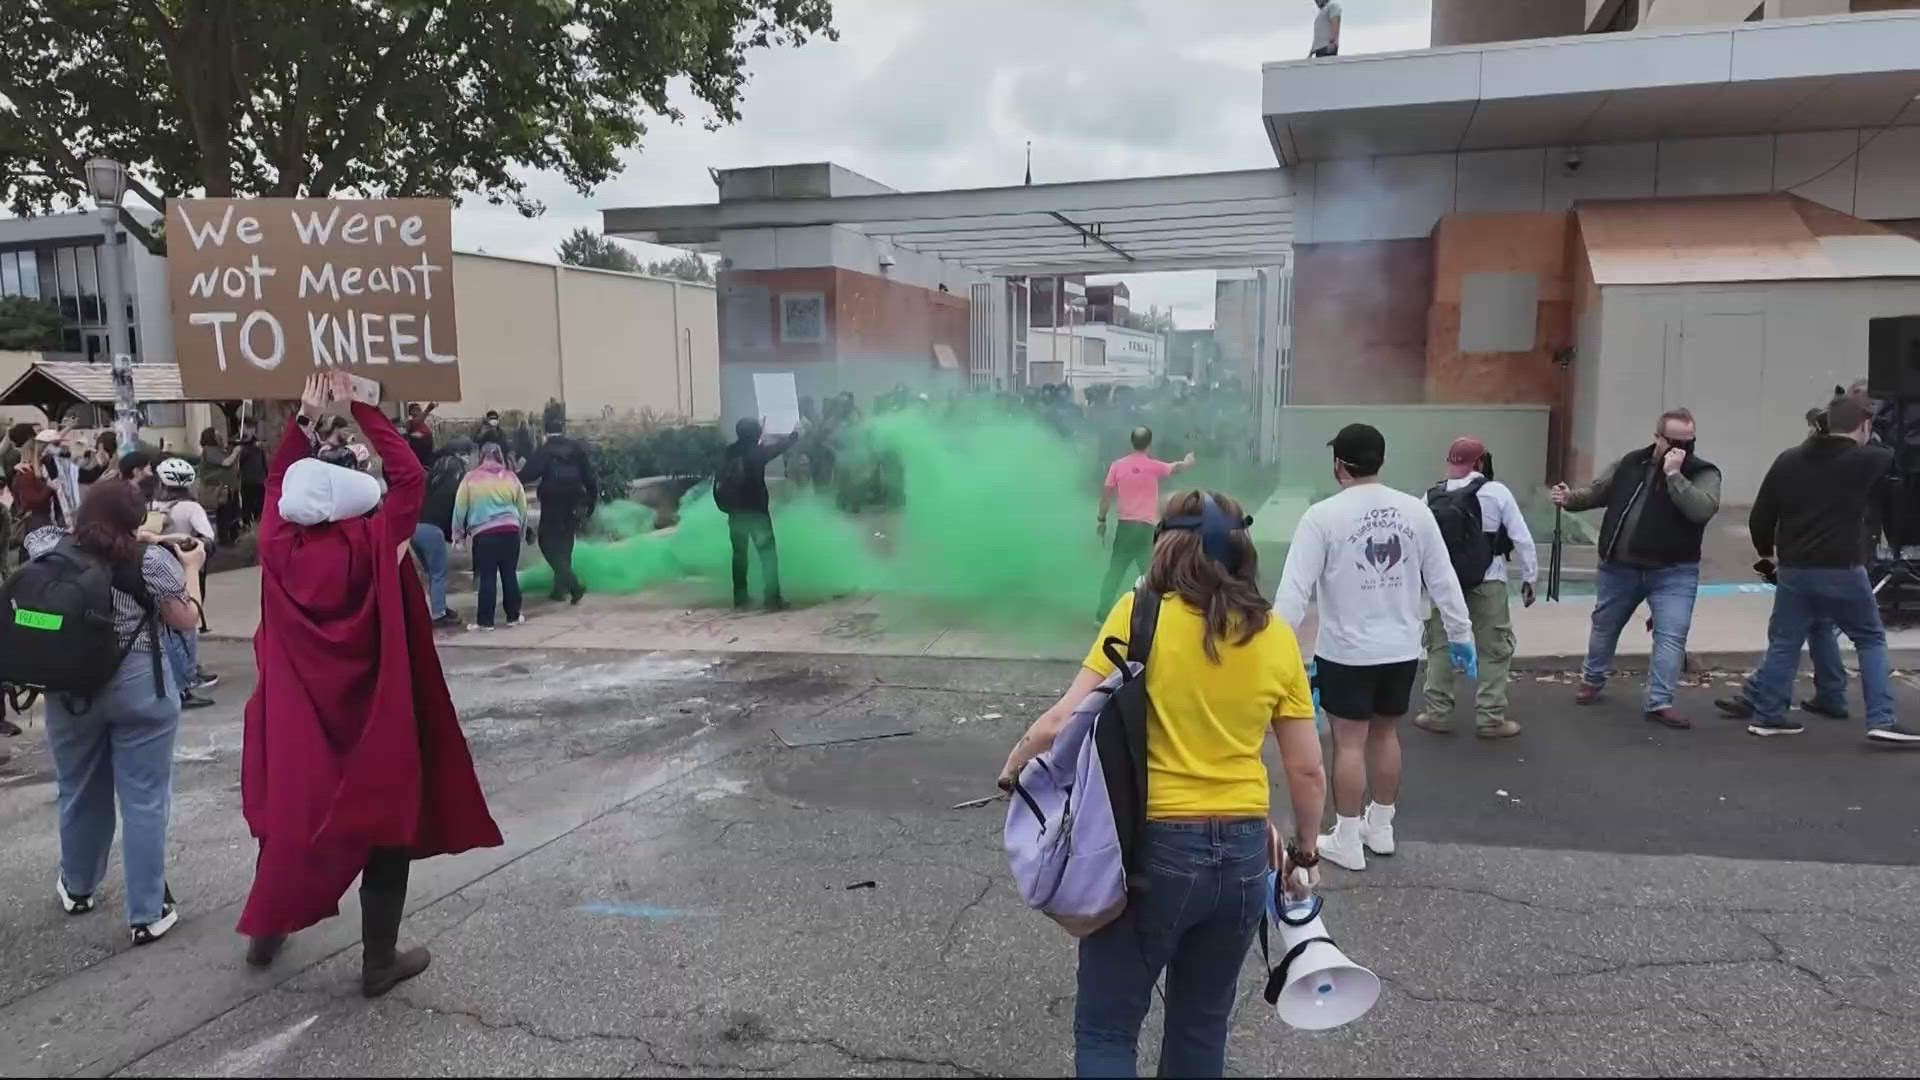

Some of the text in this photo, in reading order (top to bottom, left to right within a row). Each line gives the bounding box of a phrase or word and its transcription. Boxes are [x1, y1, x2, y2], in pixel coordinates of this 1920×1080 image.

[177, 203, 427, 251] We Were
[298, 250, 443, 302] Meant
[188, 308, 458, 372] TO KNEEL
